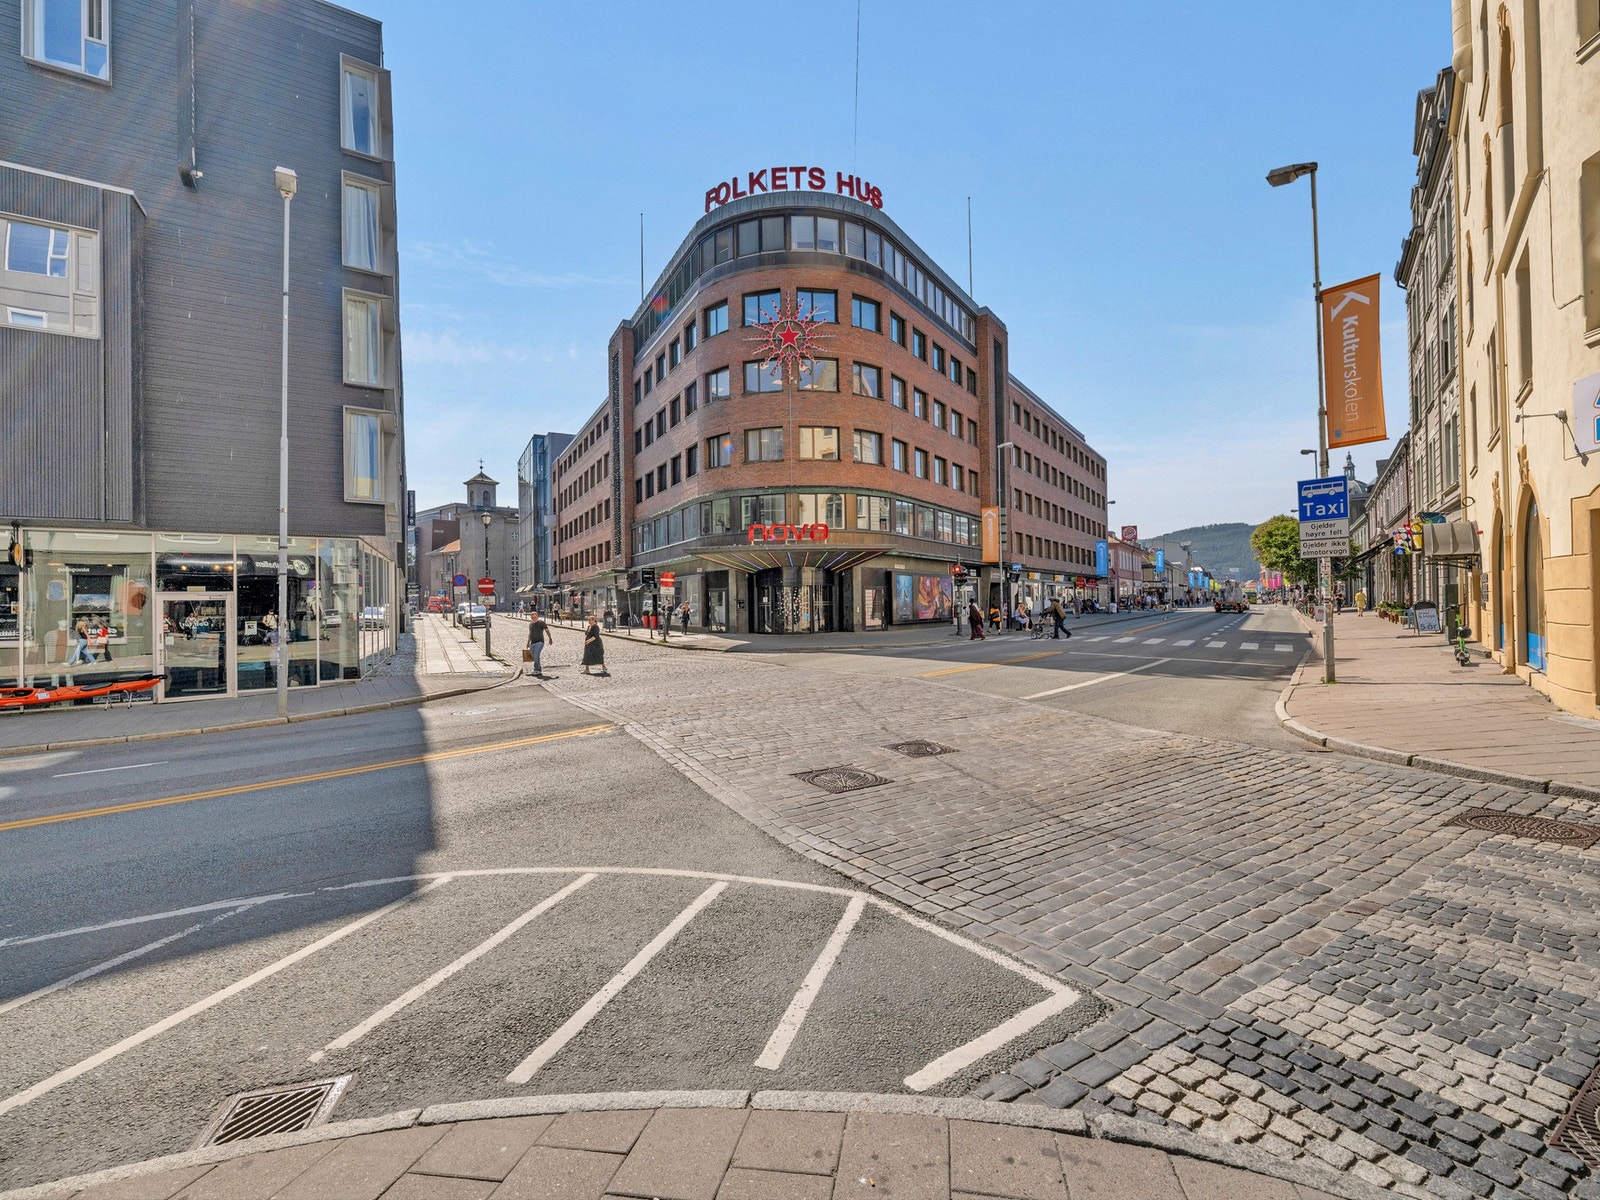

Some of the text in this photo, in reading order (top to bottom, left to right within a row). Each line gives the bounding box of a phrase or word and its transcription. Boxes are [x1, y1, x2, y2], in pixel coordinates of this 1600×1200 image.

[704, 166, 884, 213] FOLKETS HUS
[1342, 315, 1363, 422] Kulturskolen
[1302, 499, 1345, 517] Taxi
[748, 523, 829, 542] nova
[1310, 522, 1336, 530] Gjelder
[1305, 530, 1326, 538] høyre
[1302, 541, 1328, 550] Gjelder
[1302, 548, 1347, 557] elmotorvogn
